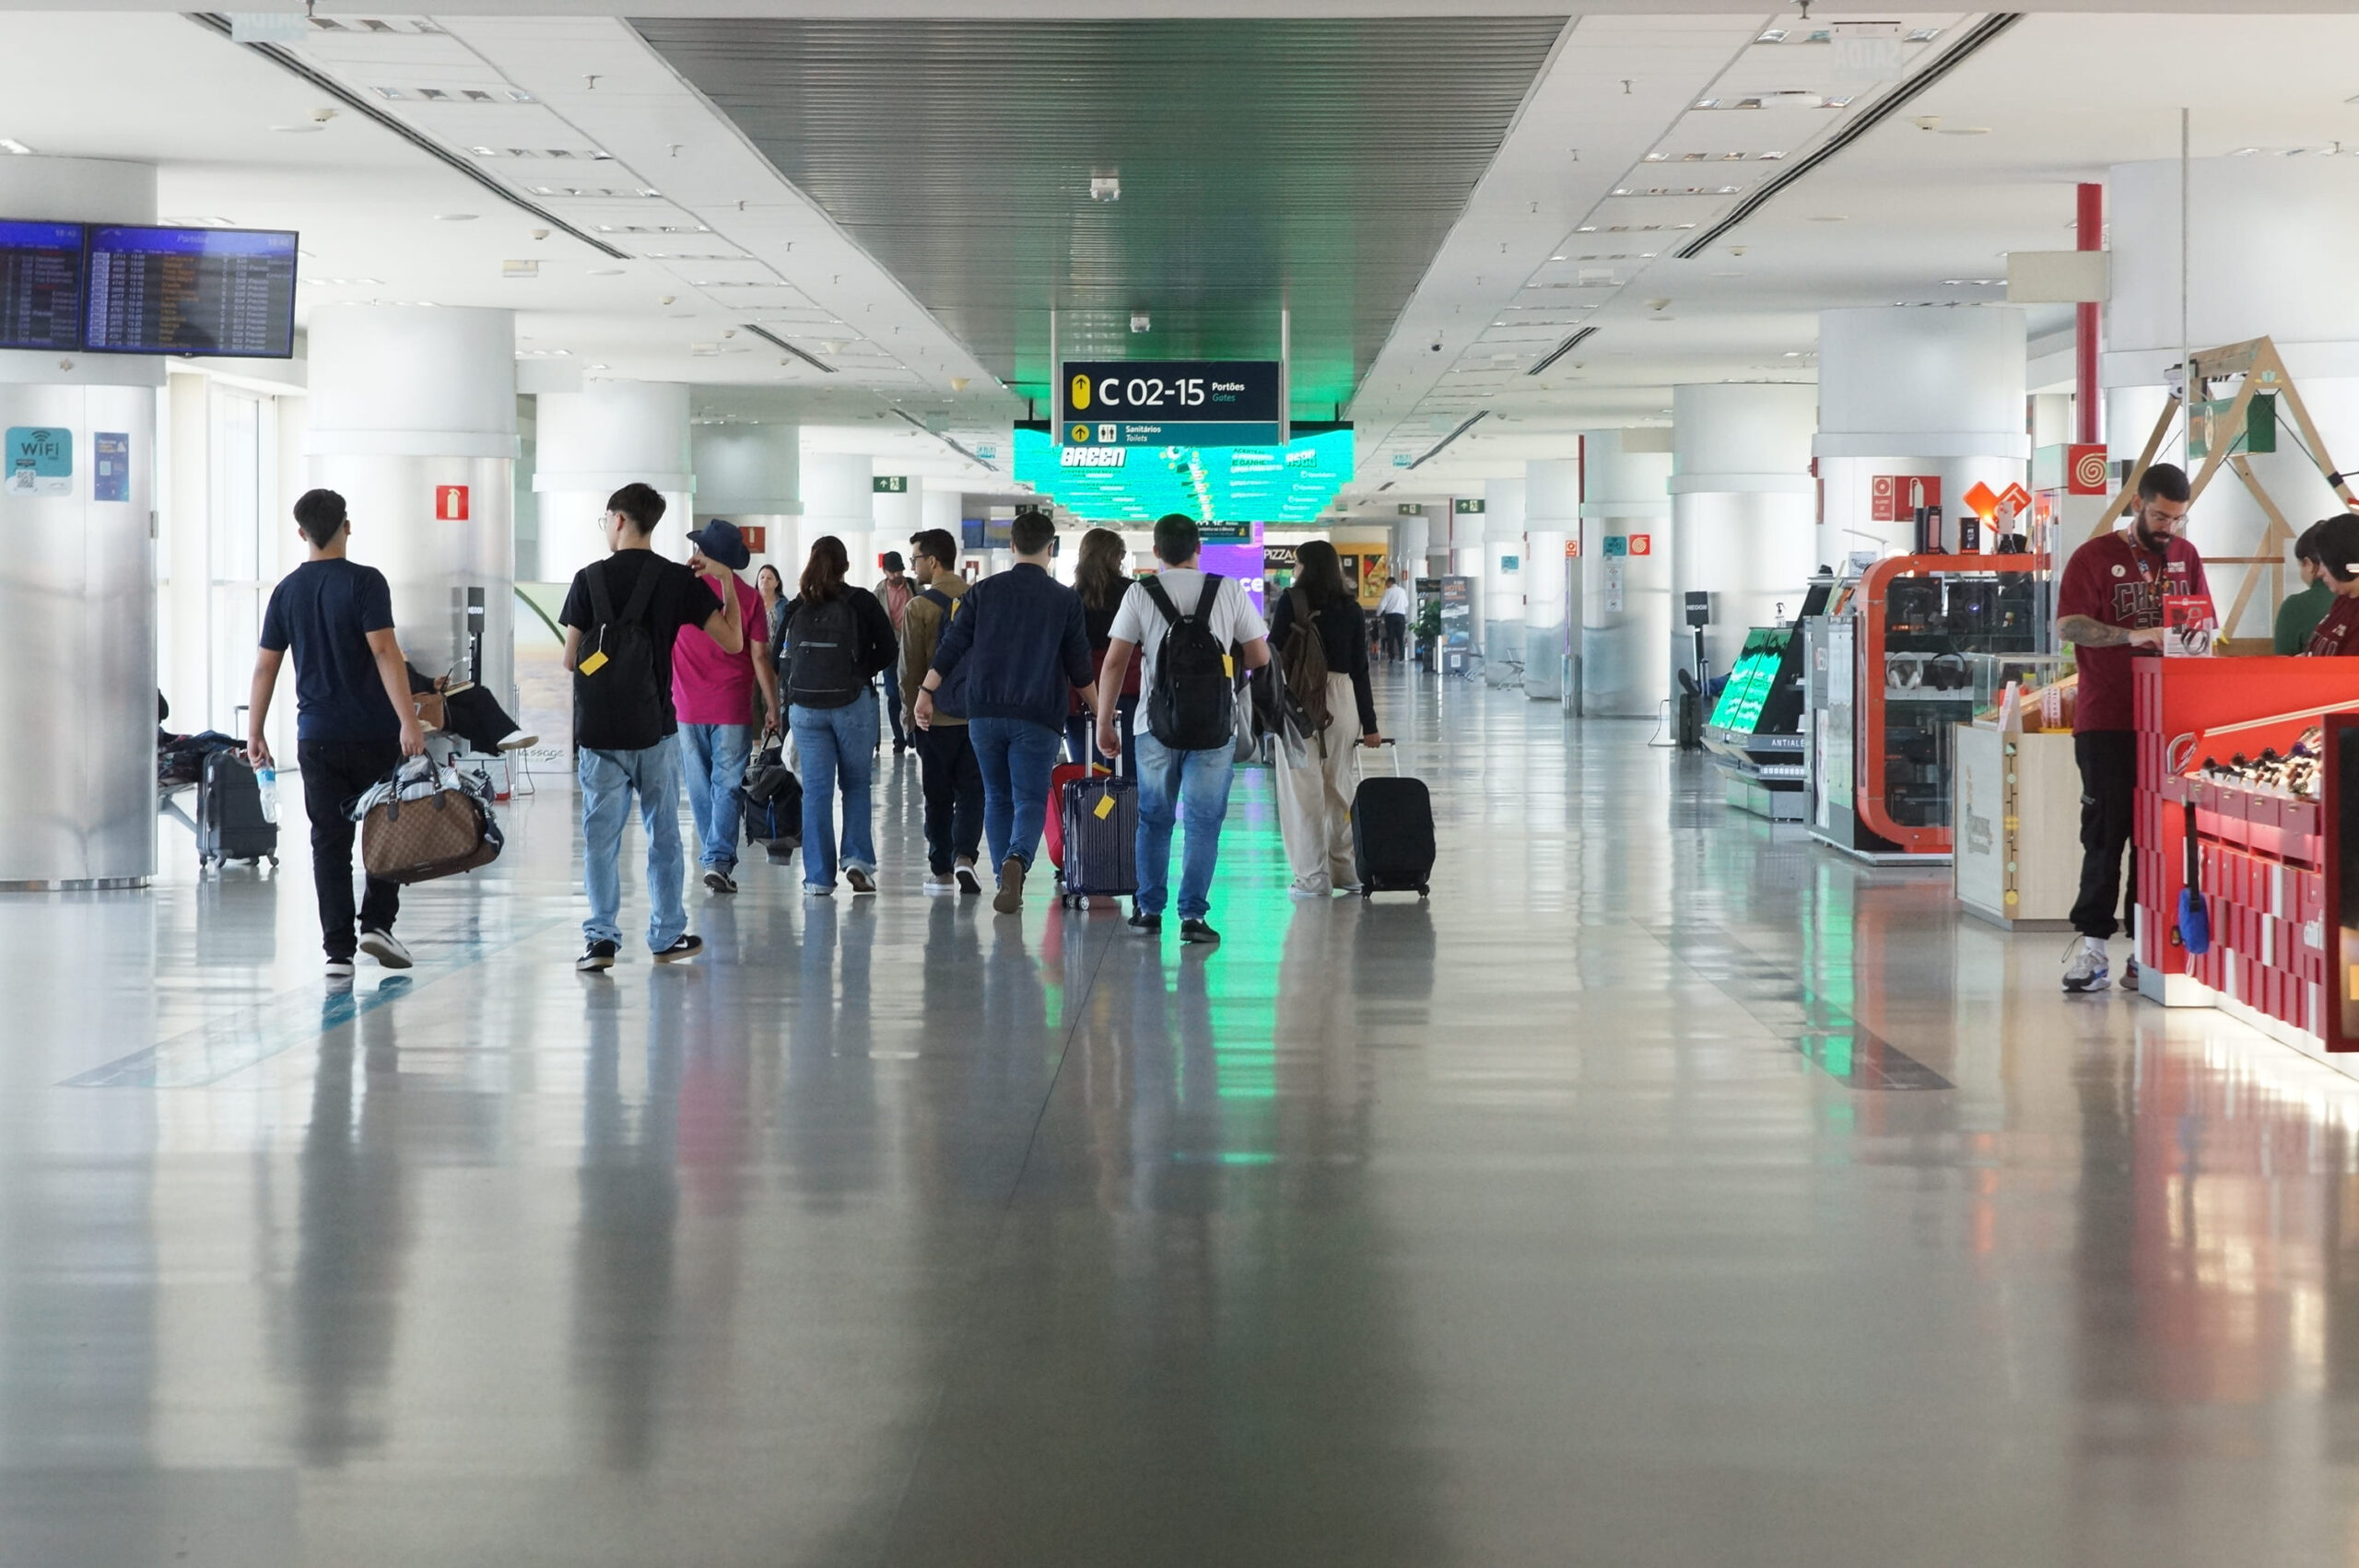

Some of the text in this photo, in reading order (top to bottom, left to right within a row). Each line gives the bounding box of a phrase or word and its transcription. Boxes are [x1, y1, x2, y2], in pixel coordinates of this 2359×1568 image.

[1098, 378, 1205, 406] C 02-15
[1212, 381, 1245, 392] Portões
[1212, 392, 1237, 403] Gates
[1125, 425, 1162, 433] Sanitários
[1126, 434, 1148, 442] Toilets
[1263, 549, 1294, 560] PIZZA
